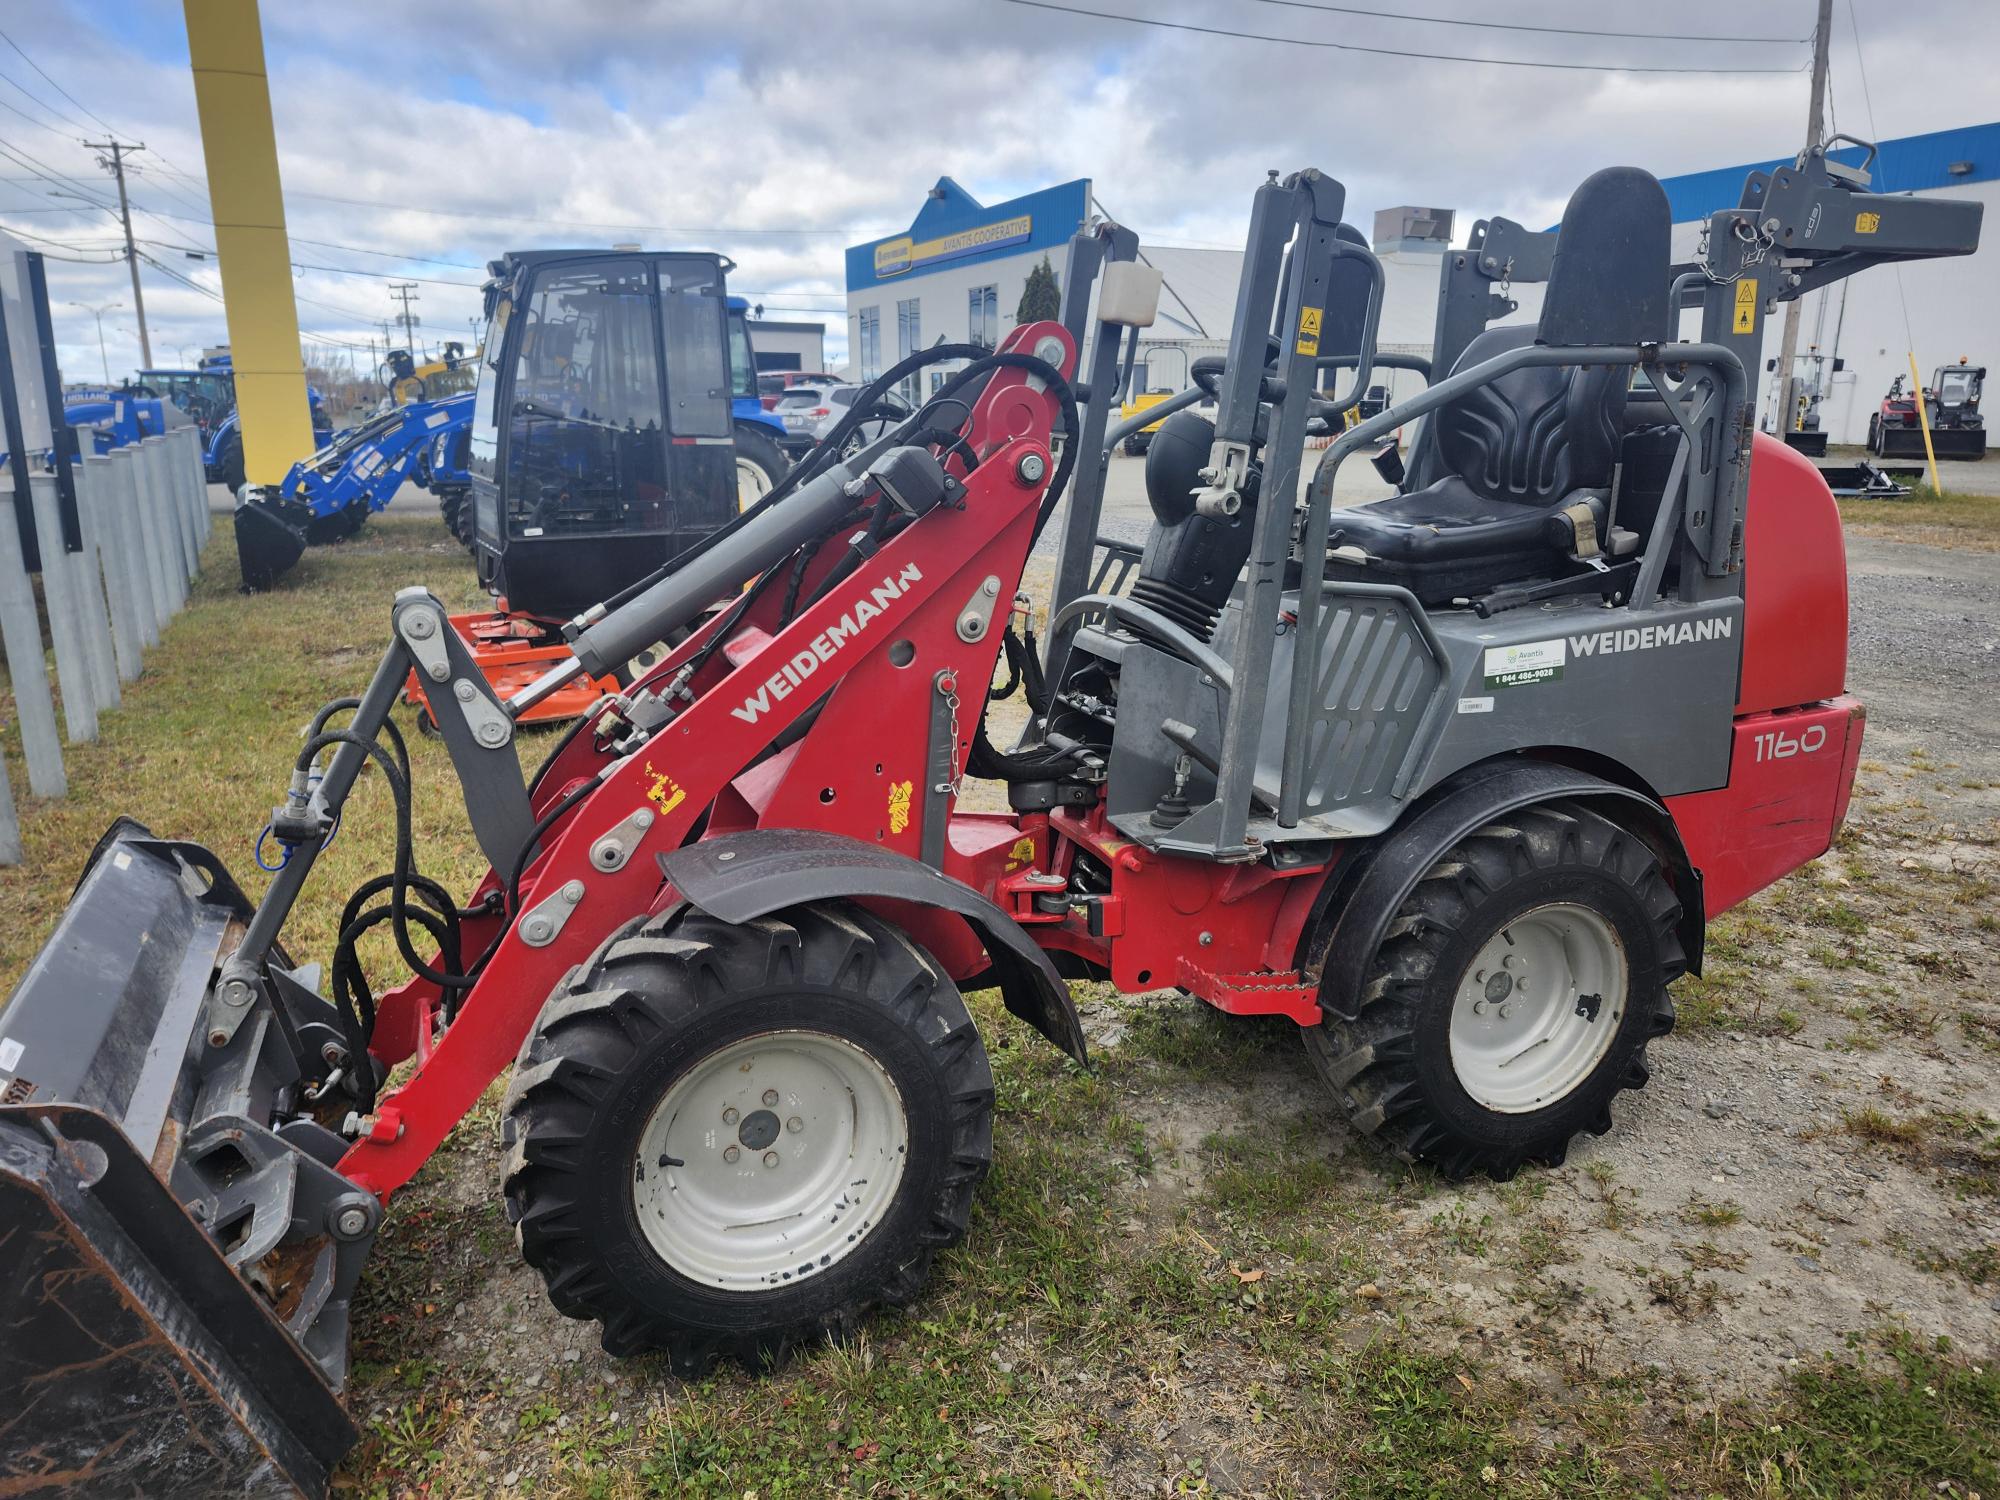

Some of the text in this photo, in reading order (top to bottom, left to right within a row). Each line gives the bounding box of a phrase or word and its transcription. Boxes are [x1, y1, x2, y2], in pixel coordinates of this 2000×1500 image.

[943, 233, 972, 251] AVANTIS
[731, 562, 924, 725] WEIDEMANN
[1569, 616, 1733, 658] WEIDEMANN
[1519, 649, 1544, 659] Avantis
[1495, 676, 1500, 684] 1
[1501, 674, 1516, 683] 844
[1518, 669, 1553, 680] 486-9028
[1754, 725, 1826, 763] 1160
